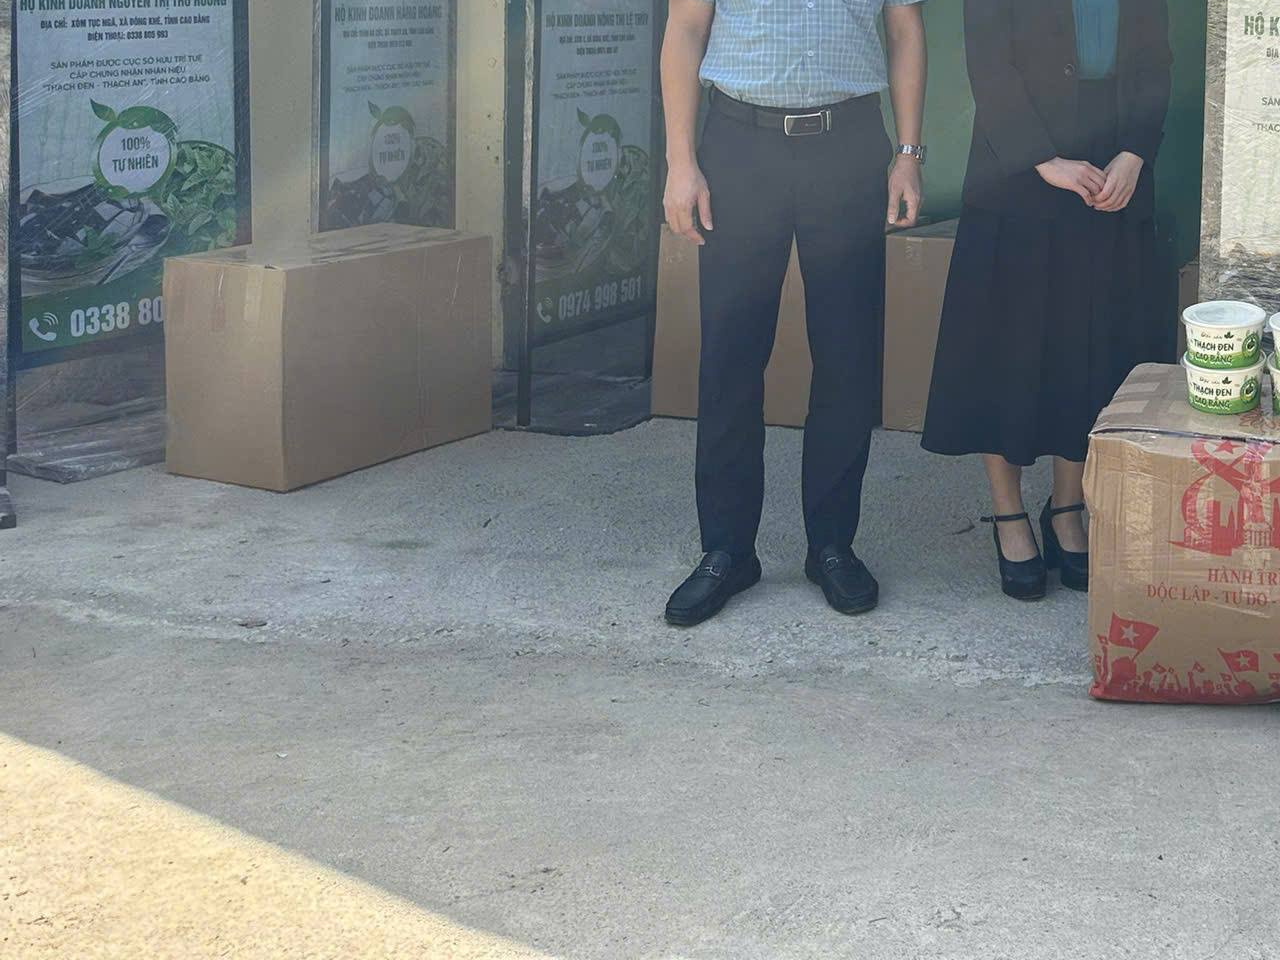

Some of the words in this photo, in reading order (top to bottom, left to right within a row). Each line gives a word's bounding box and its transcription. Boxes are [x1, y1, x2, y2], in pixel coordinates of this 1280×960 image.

[121, 136, 151, 151] 100%
[128, 154, 159, 171] NHIÊN
[70, 301, 130, 338] 0338
[138, 295, 164, 325] 80
[1208, 566, 1253, 585] HÀNH
